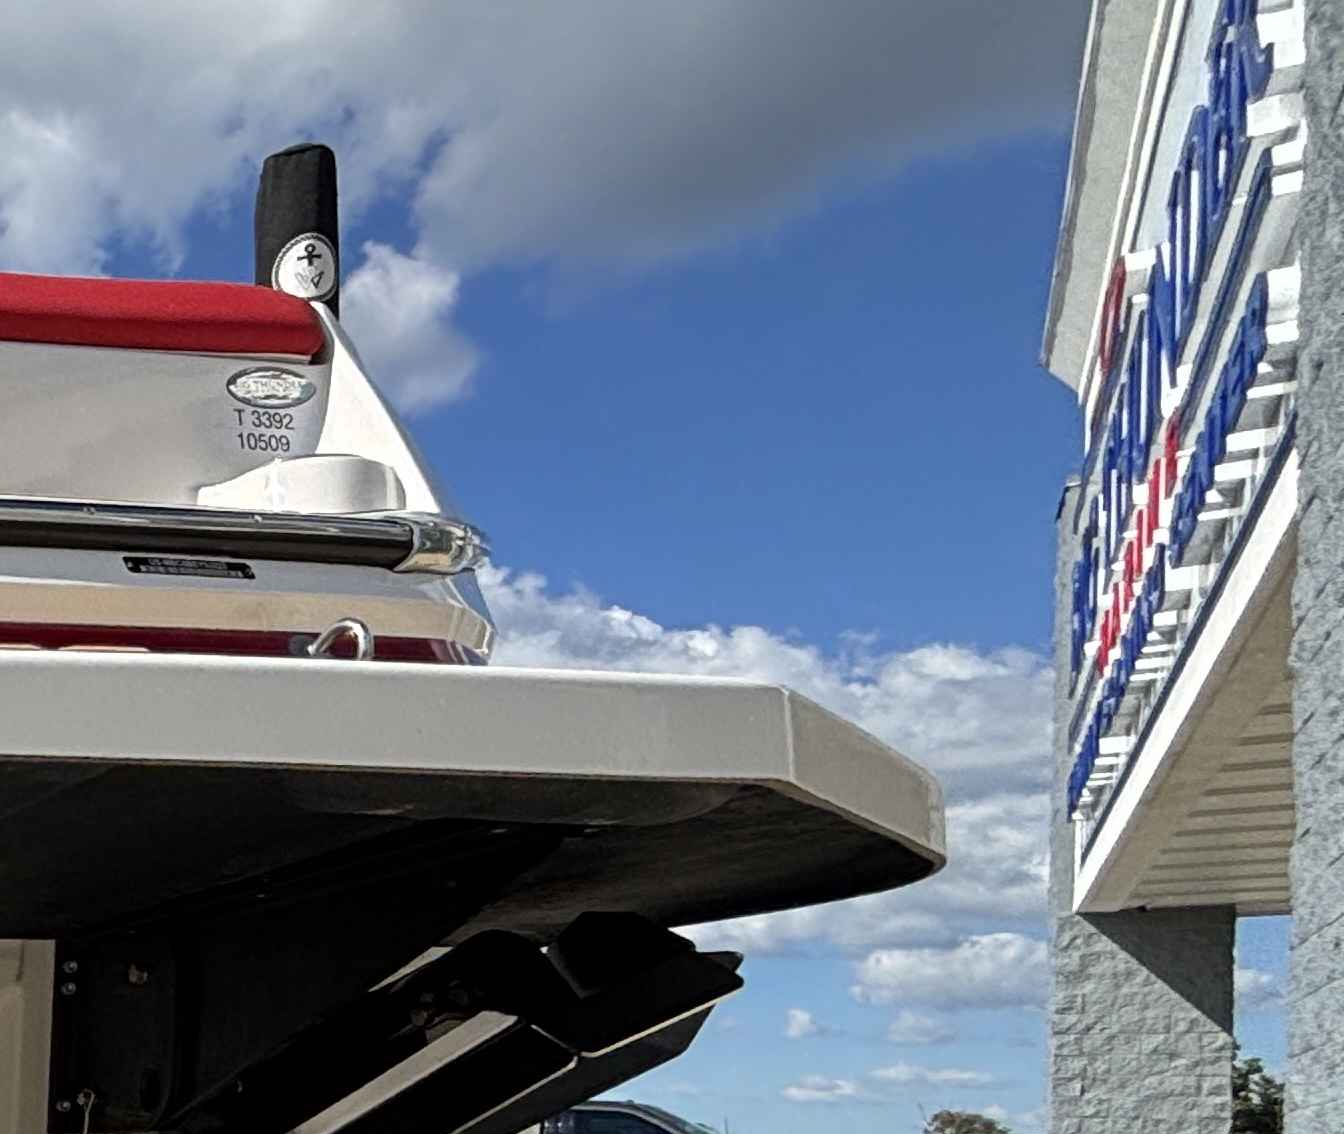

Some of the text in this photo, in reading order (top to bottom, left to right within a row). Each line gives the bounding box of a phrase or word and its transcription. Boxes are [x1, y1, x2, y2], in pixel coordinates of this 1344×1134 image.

[233, 408, 295, 430] T 3392
[237, 432, 290, 452] 10509
